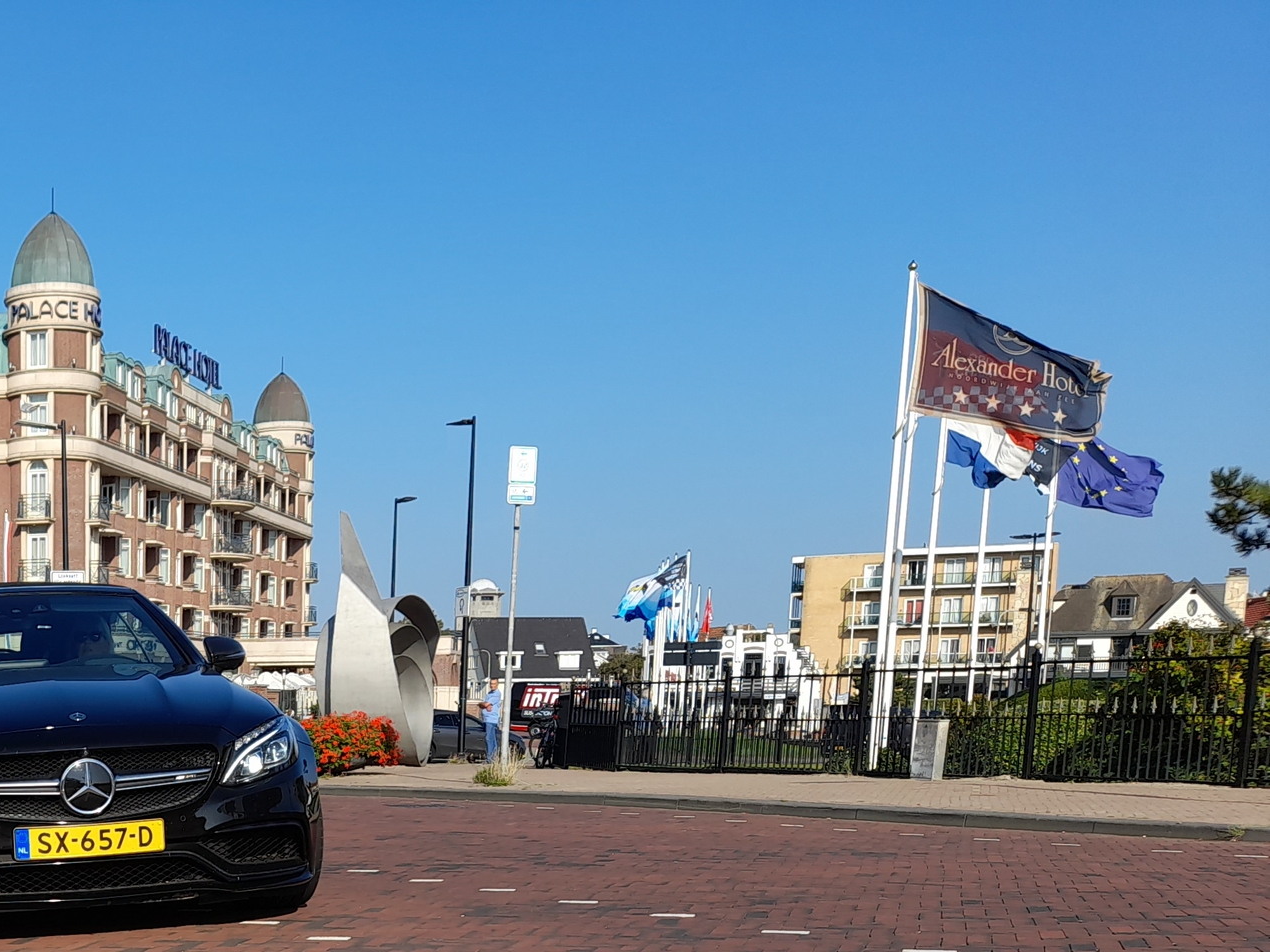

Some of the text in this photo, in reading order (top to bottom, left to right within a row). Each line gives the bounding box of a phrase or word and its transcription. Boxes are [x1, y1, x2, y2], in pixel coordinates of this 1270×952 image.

[10, 299, 79, 323] PALACE
[153, 323, 222, 390] PALACE HOTEL
[931, 337, 1037, 384] Alexander
[17, 847, 29, 855] NL
[37, 825, 153, 854] SX-657-D
